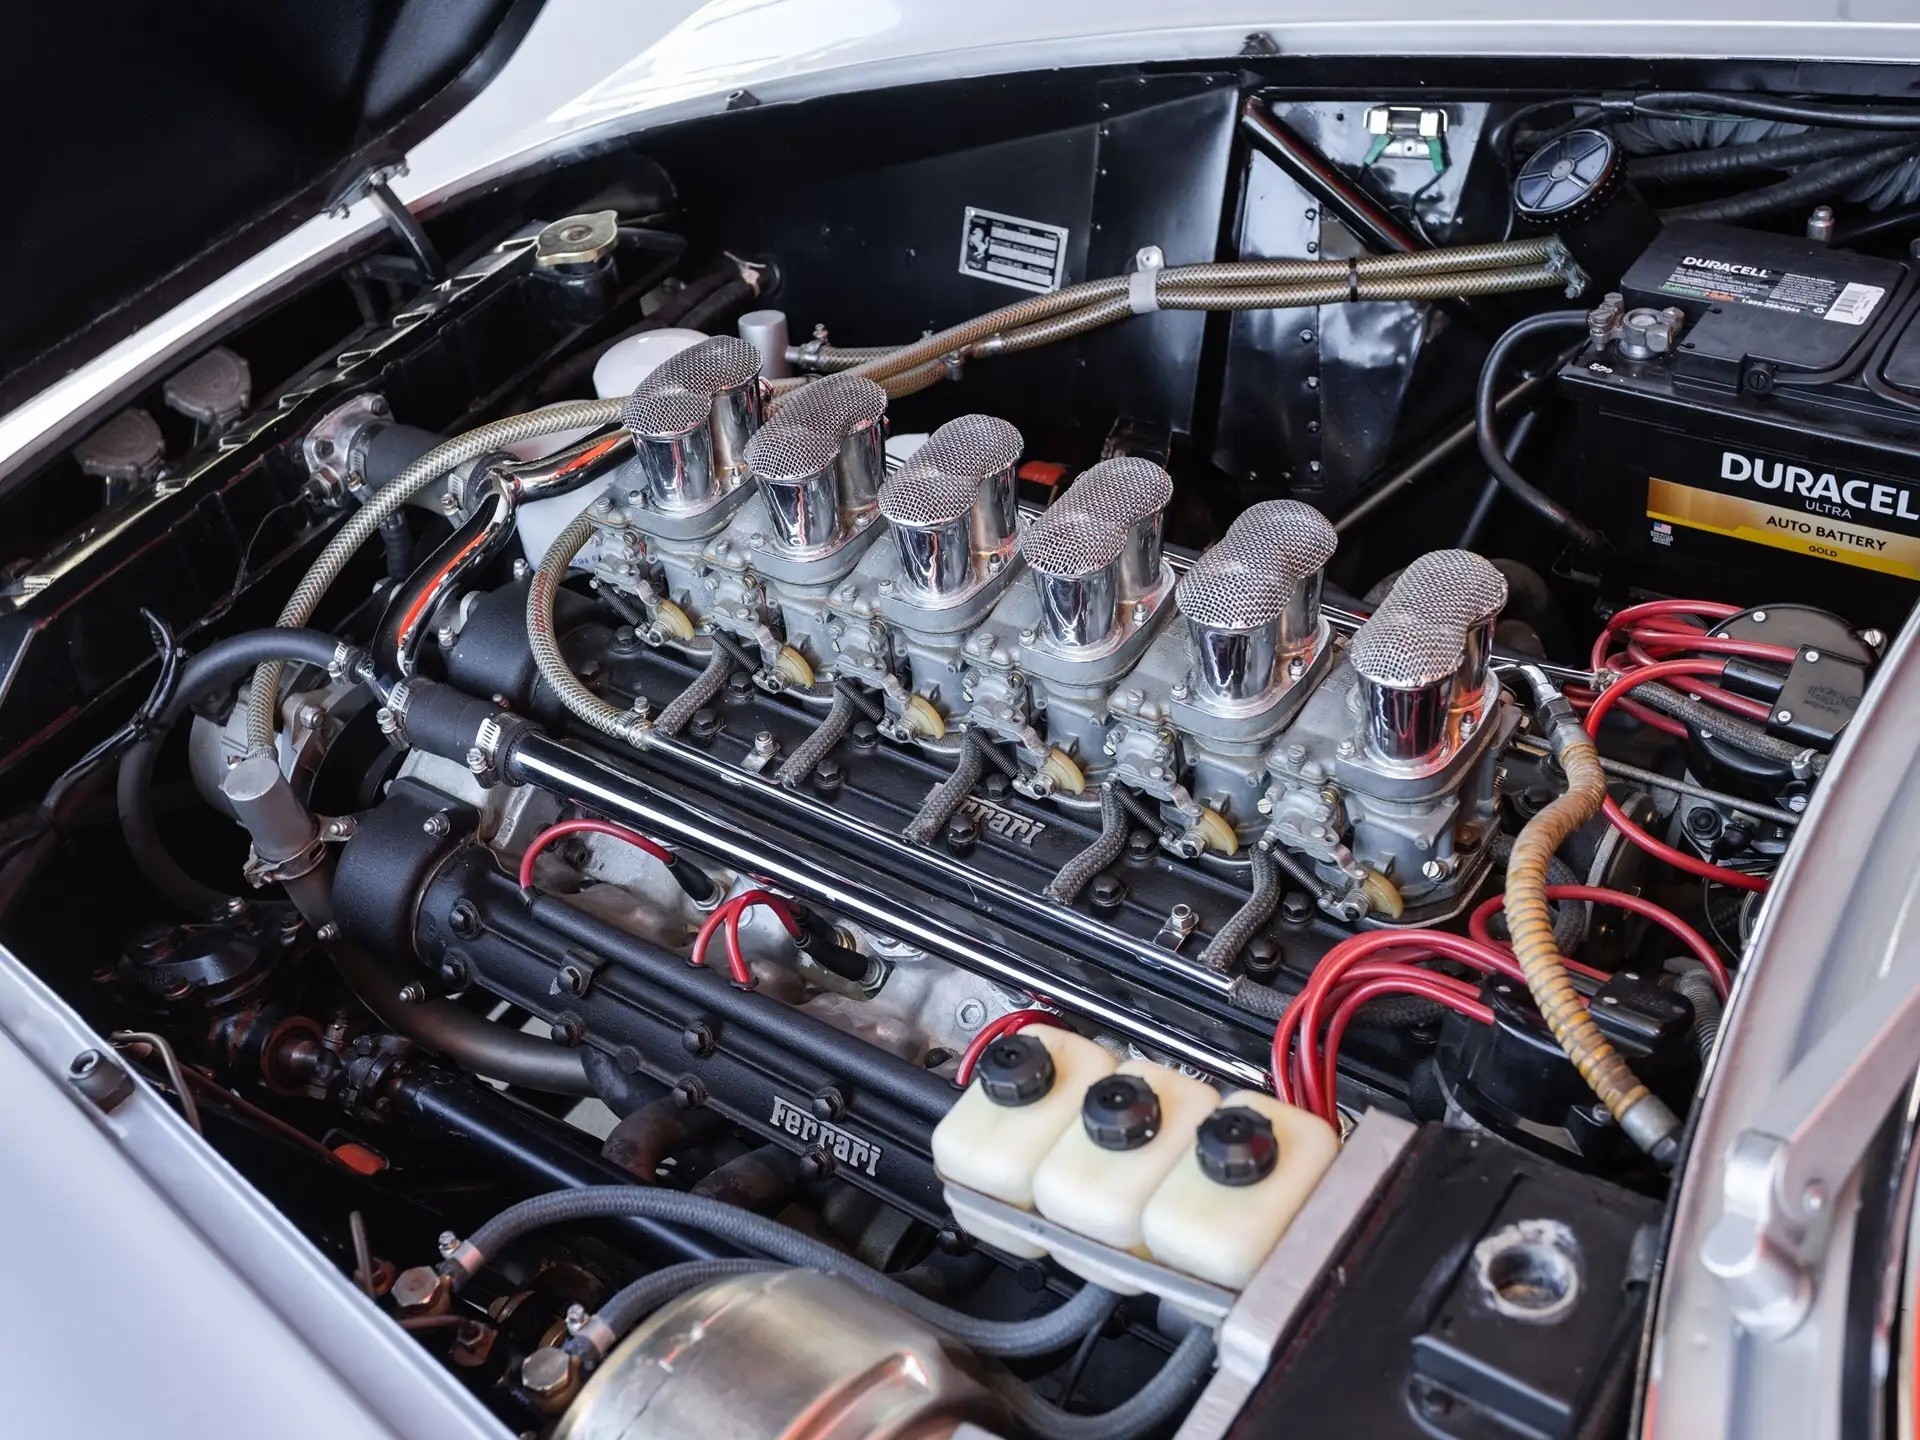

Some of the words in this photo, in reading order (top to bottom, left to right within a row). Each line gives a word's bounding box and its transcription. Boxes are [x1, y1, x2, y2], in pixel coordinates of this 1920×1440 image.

[1682, 256, 1768, 279] DURACELL
[1721, 451, 1920, 521] DURACEL
[1805, 499, 1852, 519] ULTRA
[1766, 515, 1811, 534] AUTO
[1815, 526, 1887, 551] BATTERY
[1808, 545, 1838, 558] GOLD
[924, 782, 1046, 845] rrari
[769, 1095, 882, 1177] Ferrari
